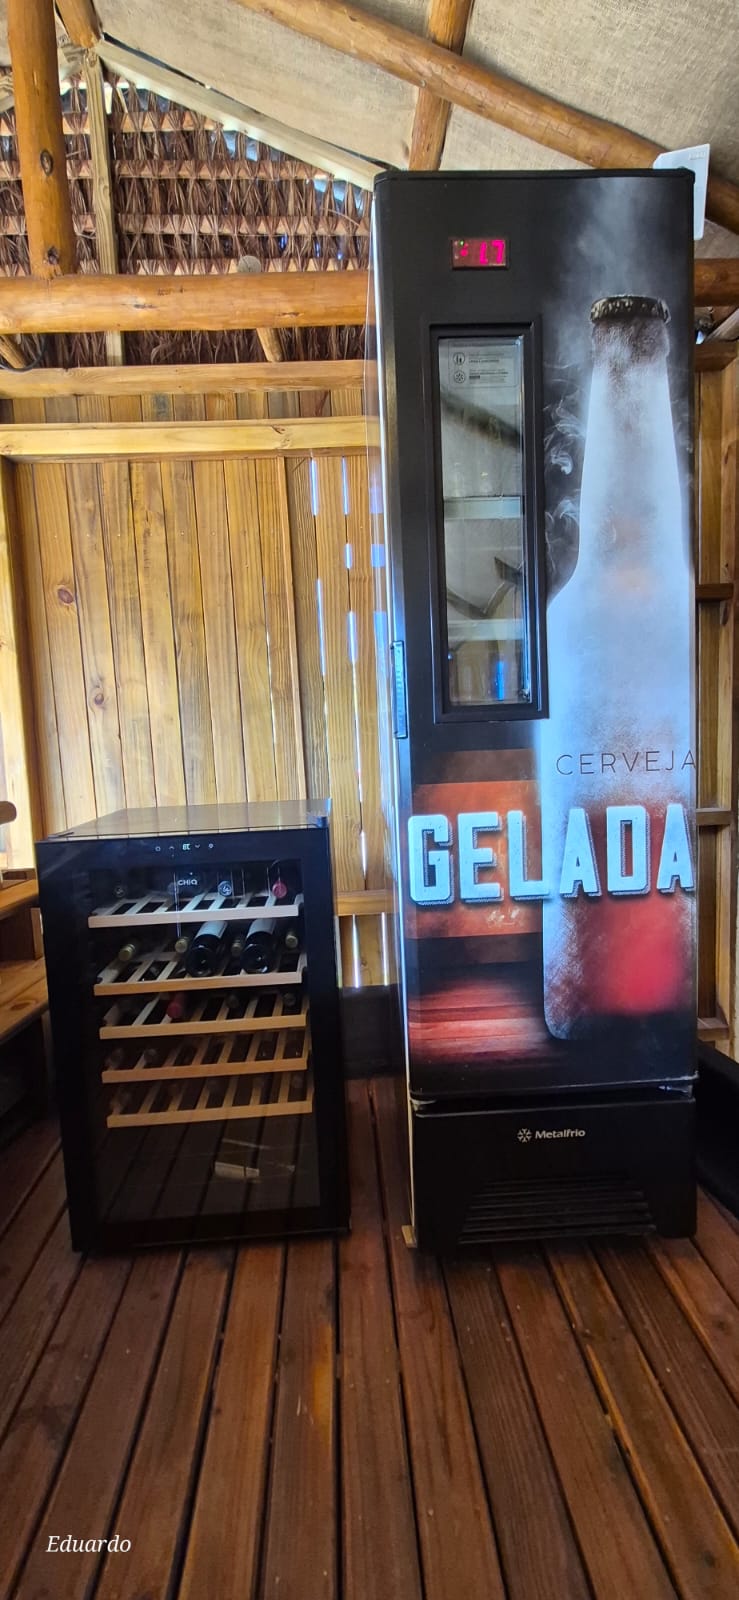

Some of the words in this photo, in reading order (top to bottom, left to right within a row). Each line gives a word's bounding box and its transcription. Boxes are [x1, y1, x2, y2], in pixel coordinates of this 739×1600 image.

[556, 749, 697, 776] CERVEJA
[408, 802, 697, 906] GELADA
[535, 1128, 586, 1139] Metalfrio
